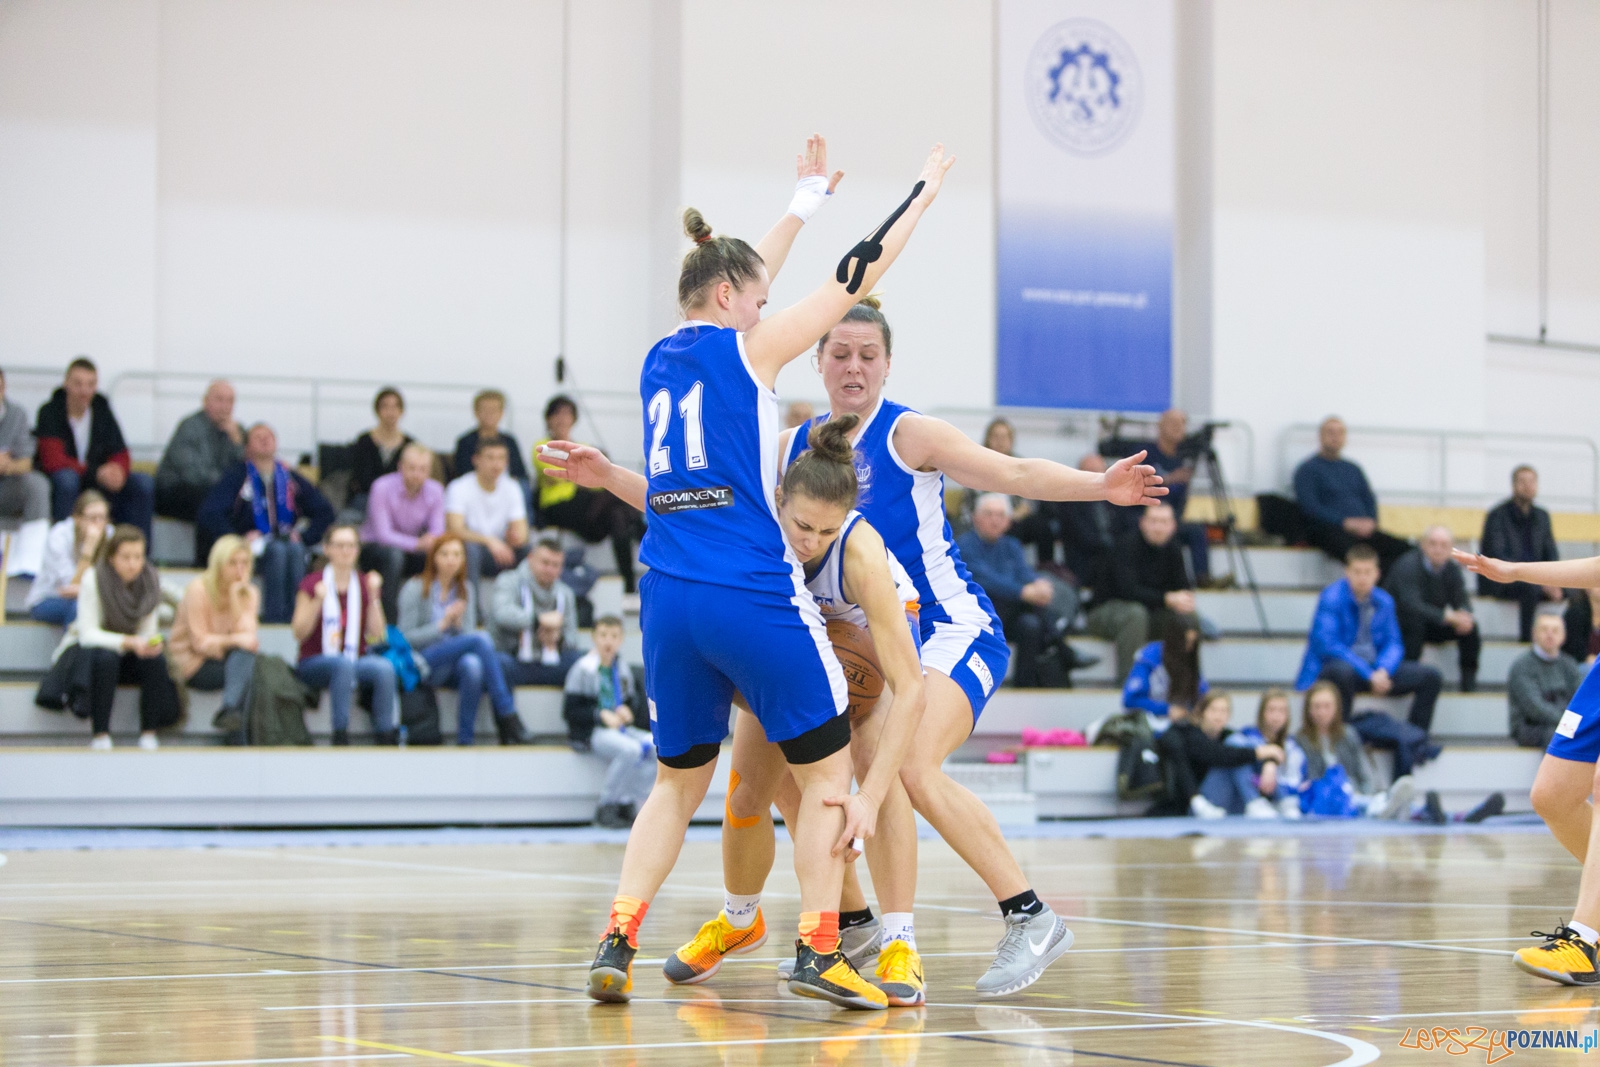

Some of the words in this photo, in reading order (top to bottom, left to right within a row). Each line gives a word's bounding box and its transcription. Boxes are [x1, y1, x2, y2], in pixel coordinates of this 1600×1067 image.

[648, 380, 708, 479] 21
[653, 489, 728, 507] PROMINENT
[842, 666, 867, 686] TF-
